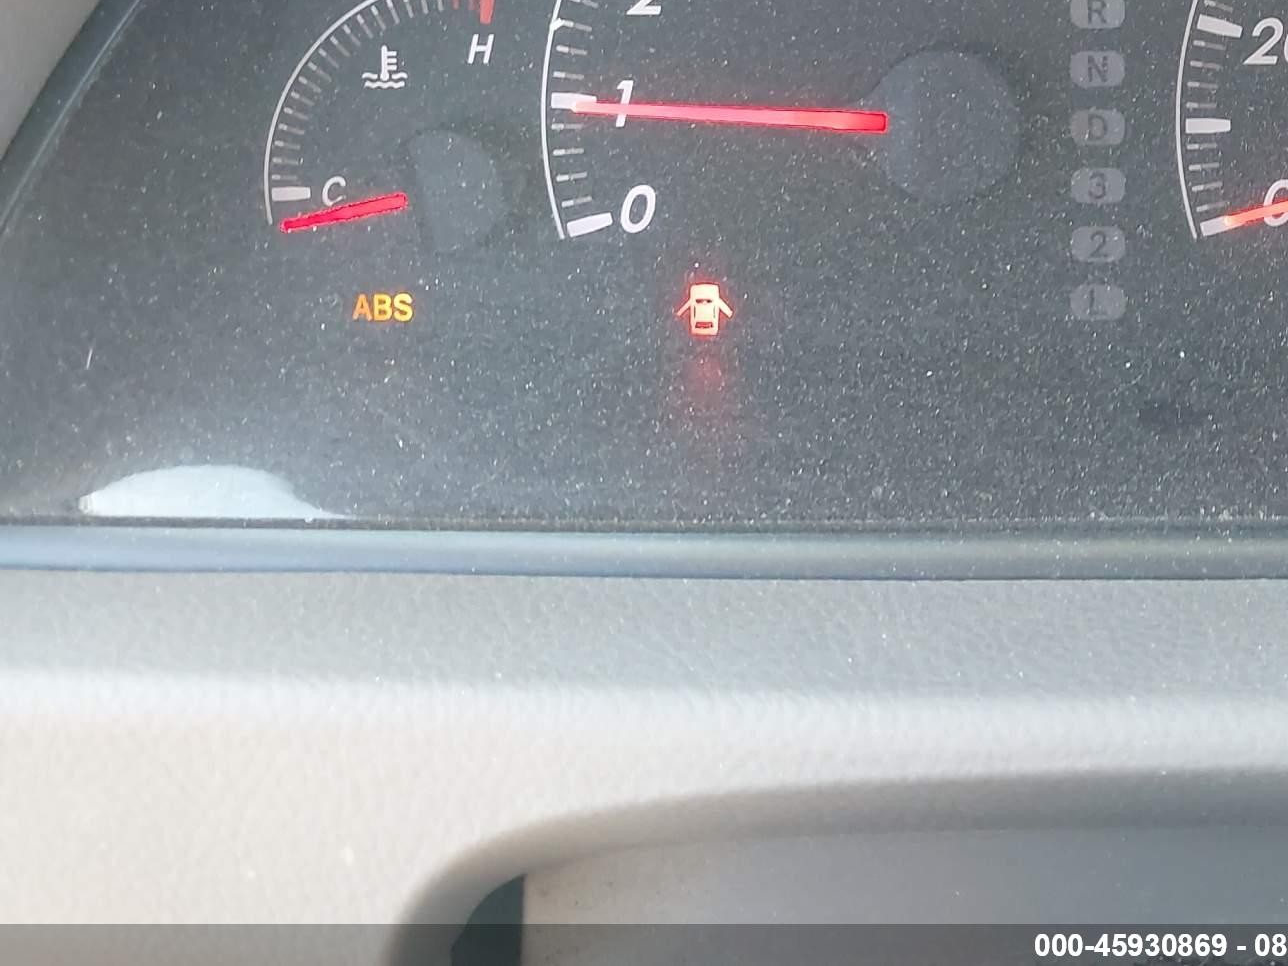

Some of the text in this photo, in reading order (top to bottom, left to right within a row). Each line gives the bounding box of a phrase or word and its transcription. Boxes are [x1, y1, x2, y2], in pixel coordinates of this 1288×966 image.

[467, 34, 495, 64] H
[1088, 55, 1108, 82] N
[615, 79, 635, 127] 1
[1088, 114, 1108, 140] D
[322, 177, 347, 206] C
[1088, 172, 1107, 199] 3
[620, 185, 656, 233] 0
[1089, 233, 1108, 259] 2
[353, 294, 414, 322] ABS
